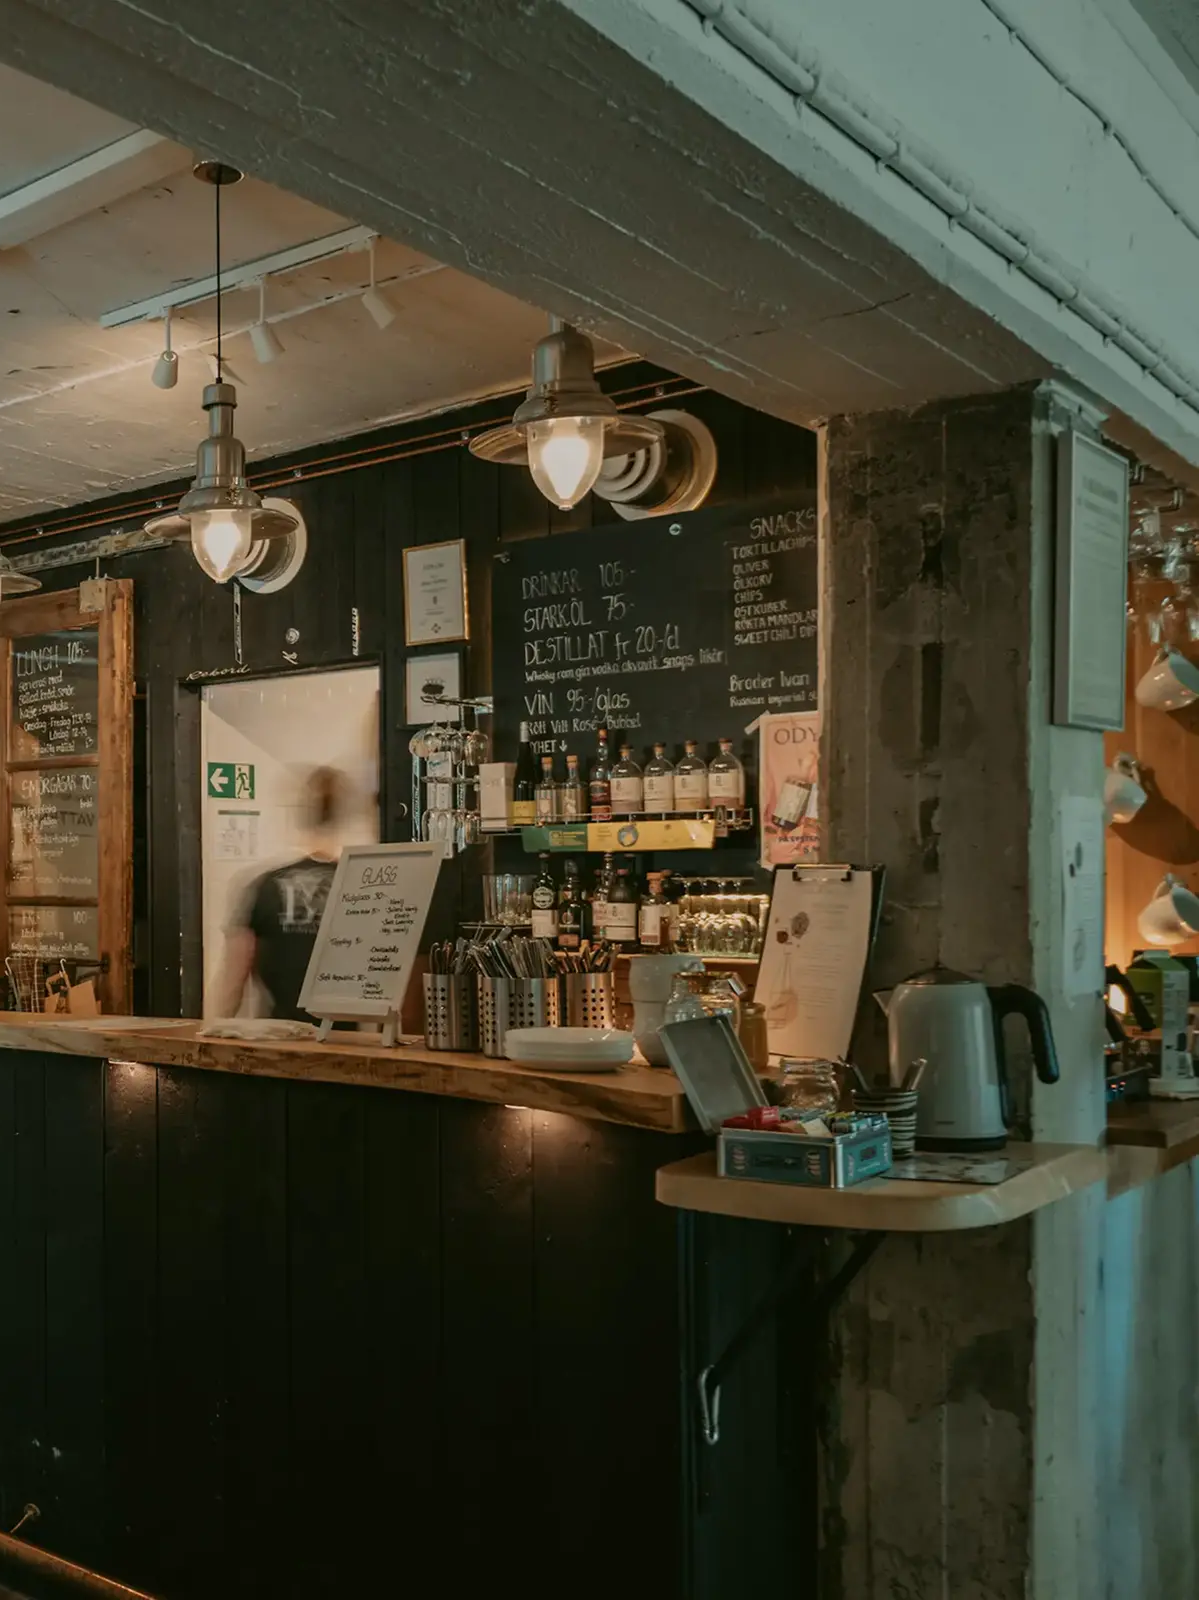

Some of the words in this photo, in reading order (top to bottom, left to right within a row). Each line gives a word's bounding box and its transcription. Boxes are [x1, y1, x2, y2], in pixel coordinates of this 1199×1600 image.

[749, 507, 817, 540] SNACKS
[732, 559, 770, 576] OLIVER
[521, 568, 583, 600] DRINKAR
[733, 573, 774, 591] ÖLKORV
[733, 589, 764, 605] CHIPS
[523, 597, 593, 633] STARKÖL
[733, 599, 789, 620] OSTKUBER
[733, 615, 767, 633] RÖKTA
[523, 629, 610, 666] DESTILLAT
[16, 644, 59, 678] LUNCH
[779, 670, 810, 689] Ivan
[524, 689, 555, 717] VIN
[530, 739, 558, 755] YHET
[361, 864, 399, 885] GLASS
